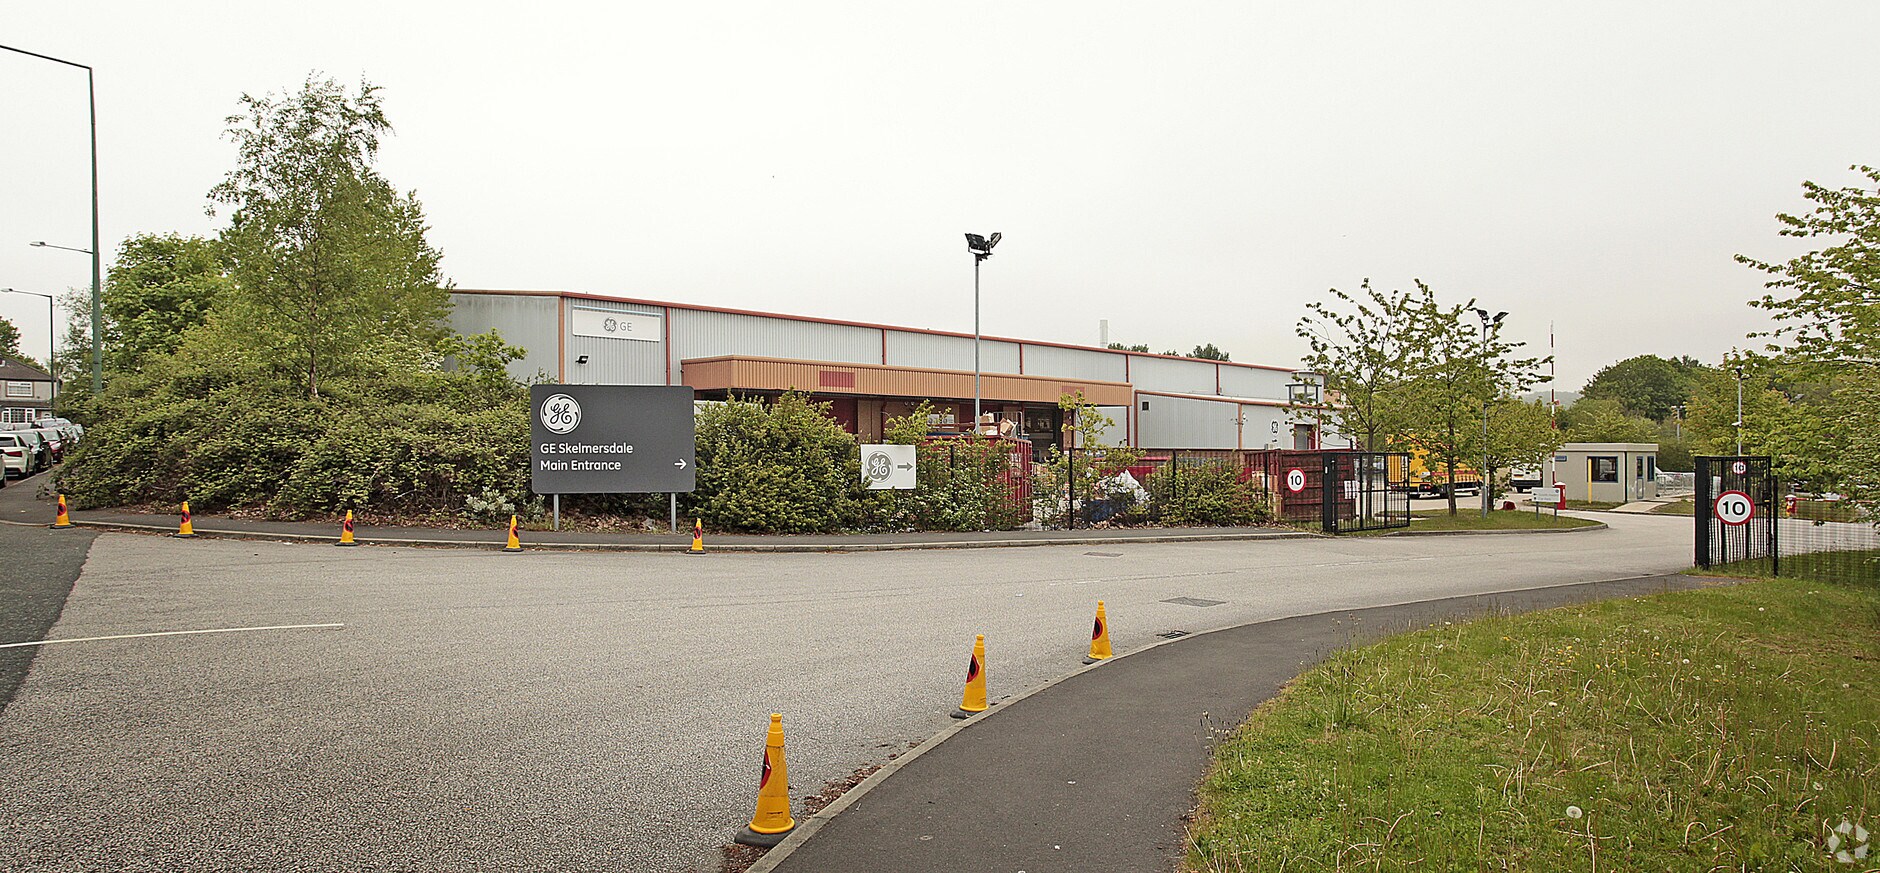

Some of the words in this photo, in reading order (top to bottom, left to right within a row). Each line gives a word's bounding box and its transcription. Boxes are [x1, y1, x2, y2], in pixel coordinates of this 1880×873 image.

[620, 321, 632, 332] GE
[540, 443, 556, 454] GE
[558, 442, 634, 454] Skelmersdale
[540, 460, 568, 471] Main
[571, 460, 621, 471] Entrance
[1290, 475, 1302, 486] 10
[1722, 500, 1746, 516] 10
